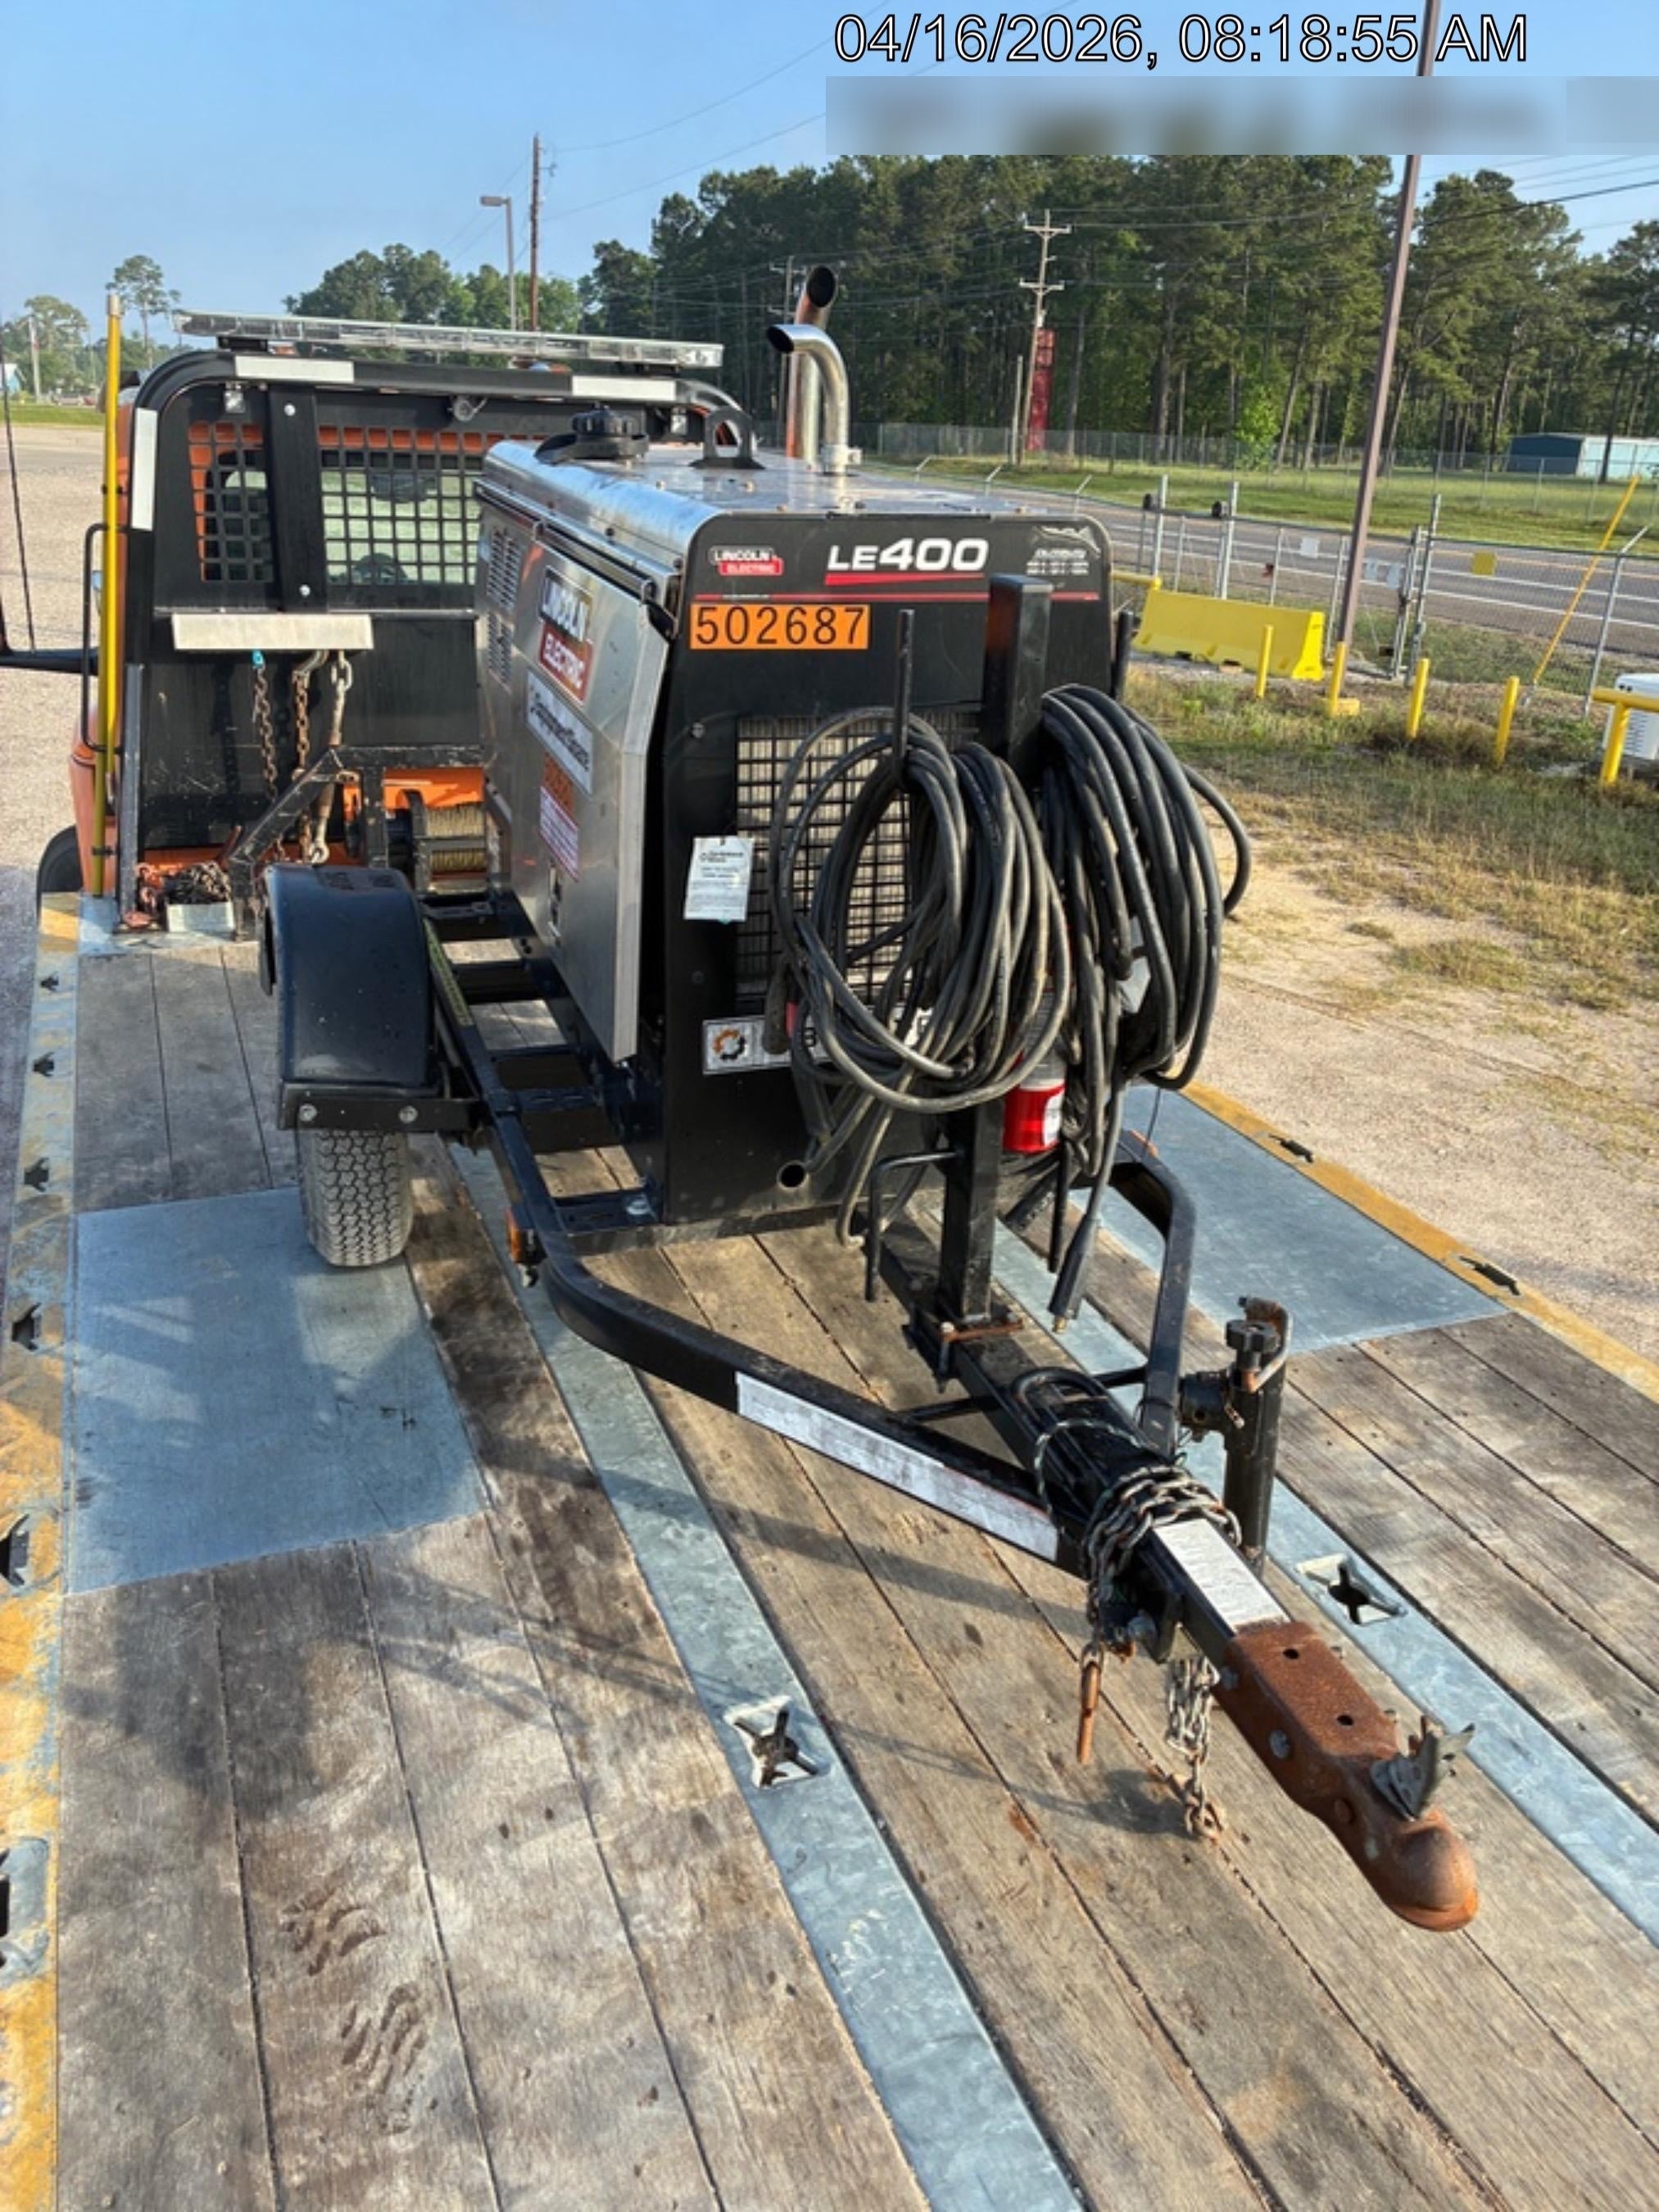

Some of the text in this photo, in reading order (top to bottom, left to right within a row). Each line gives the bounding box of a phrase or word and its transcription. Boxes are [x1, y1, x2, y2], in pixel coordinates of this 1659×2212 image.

[714, 550, 770, 561] LINCOLN
[827, 537, 990, 571] LE400
[695, 605, 865, 645] 502687
